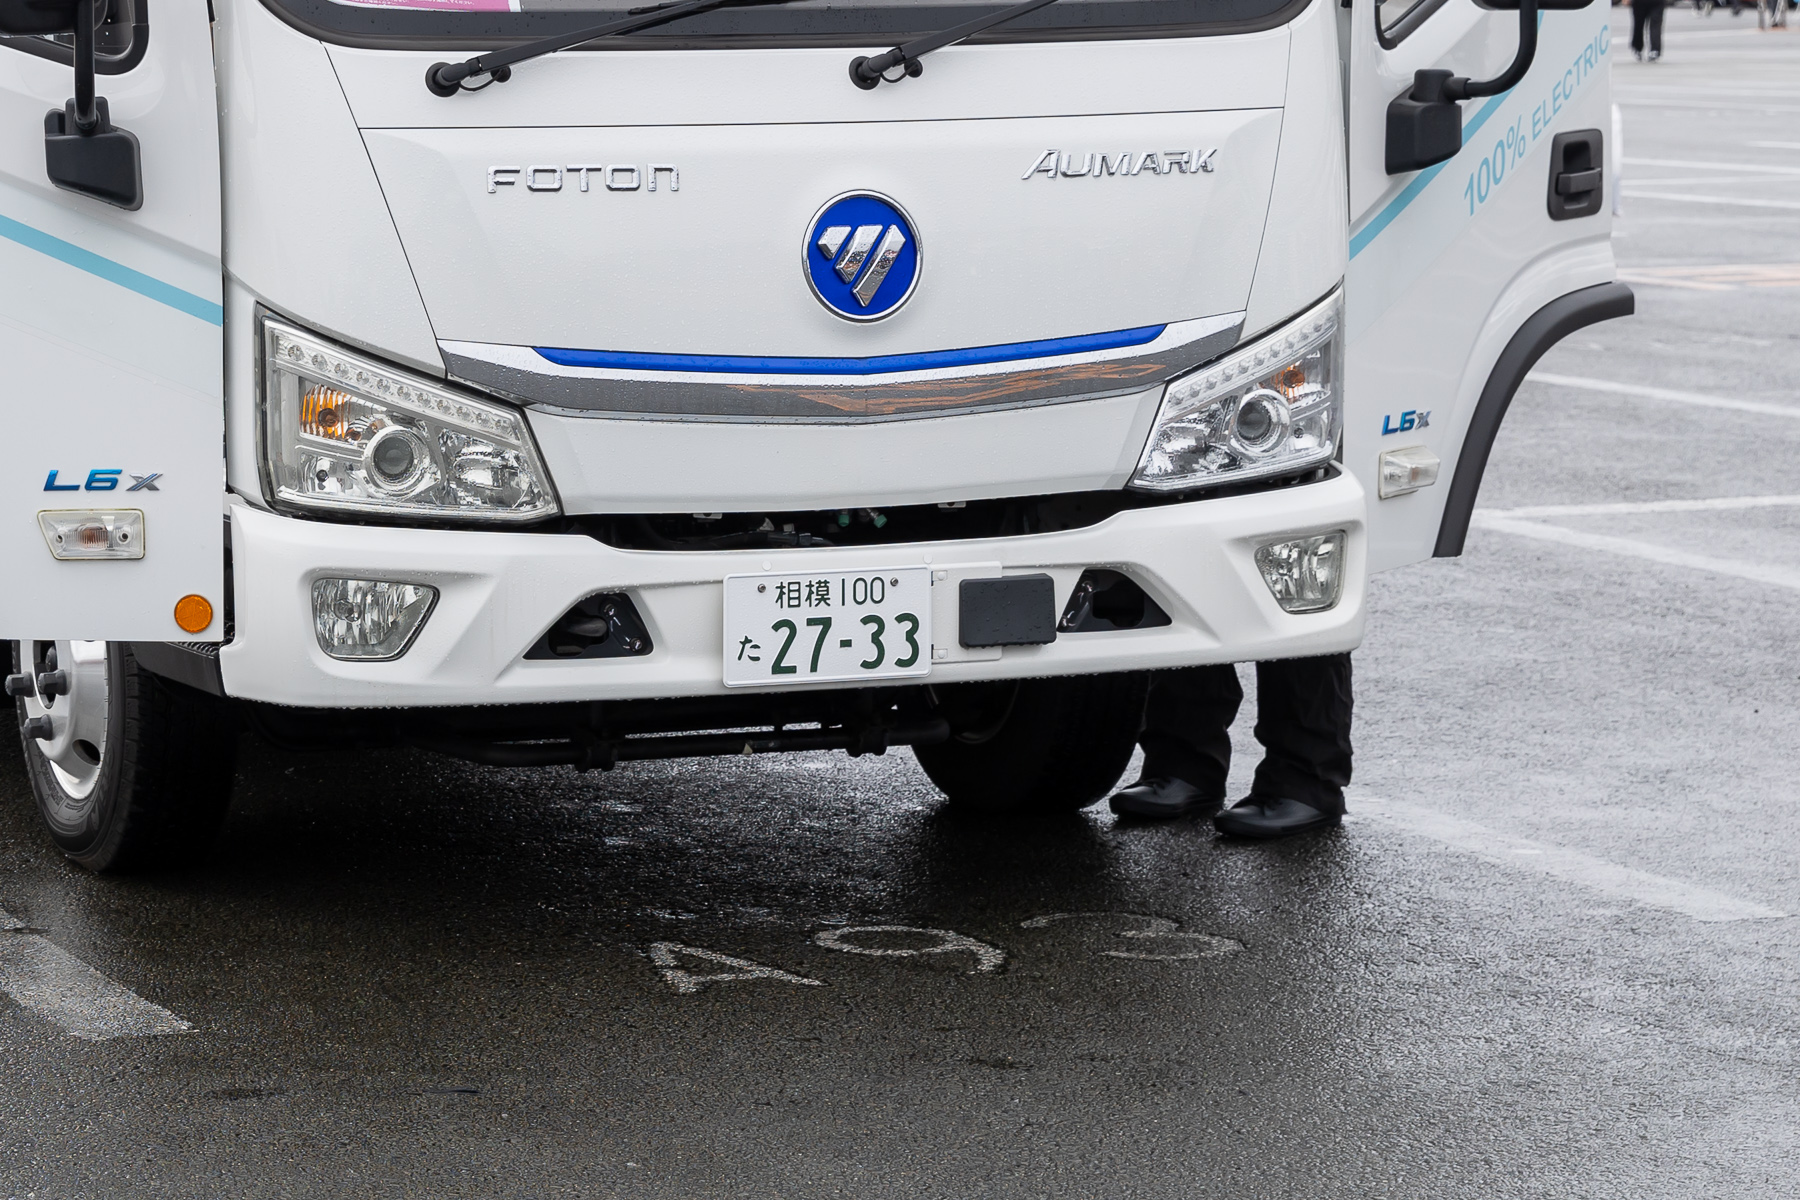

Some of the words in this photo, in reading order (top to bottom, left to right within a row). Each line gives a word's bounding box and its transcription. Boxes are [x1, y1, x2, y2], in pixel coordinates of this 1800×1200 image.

[1463, 114, 1527, 217] 100%
[1531, 24, 1610, 142] ELECTRIC
[486, 163, 680, 194] FOTON
[1020, 148, 1218, 181] AUMARK
[737, 635, 761, 661] た
[771, 612, 920, 675] 27-33
